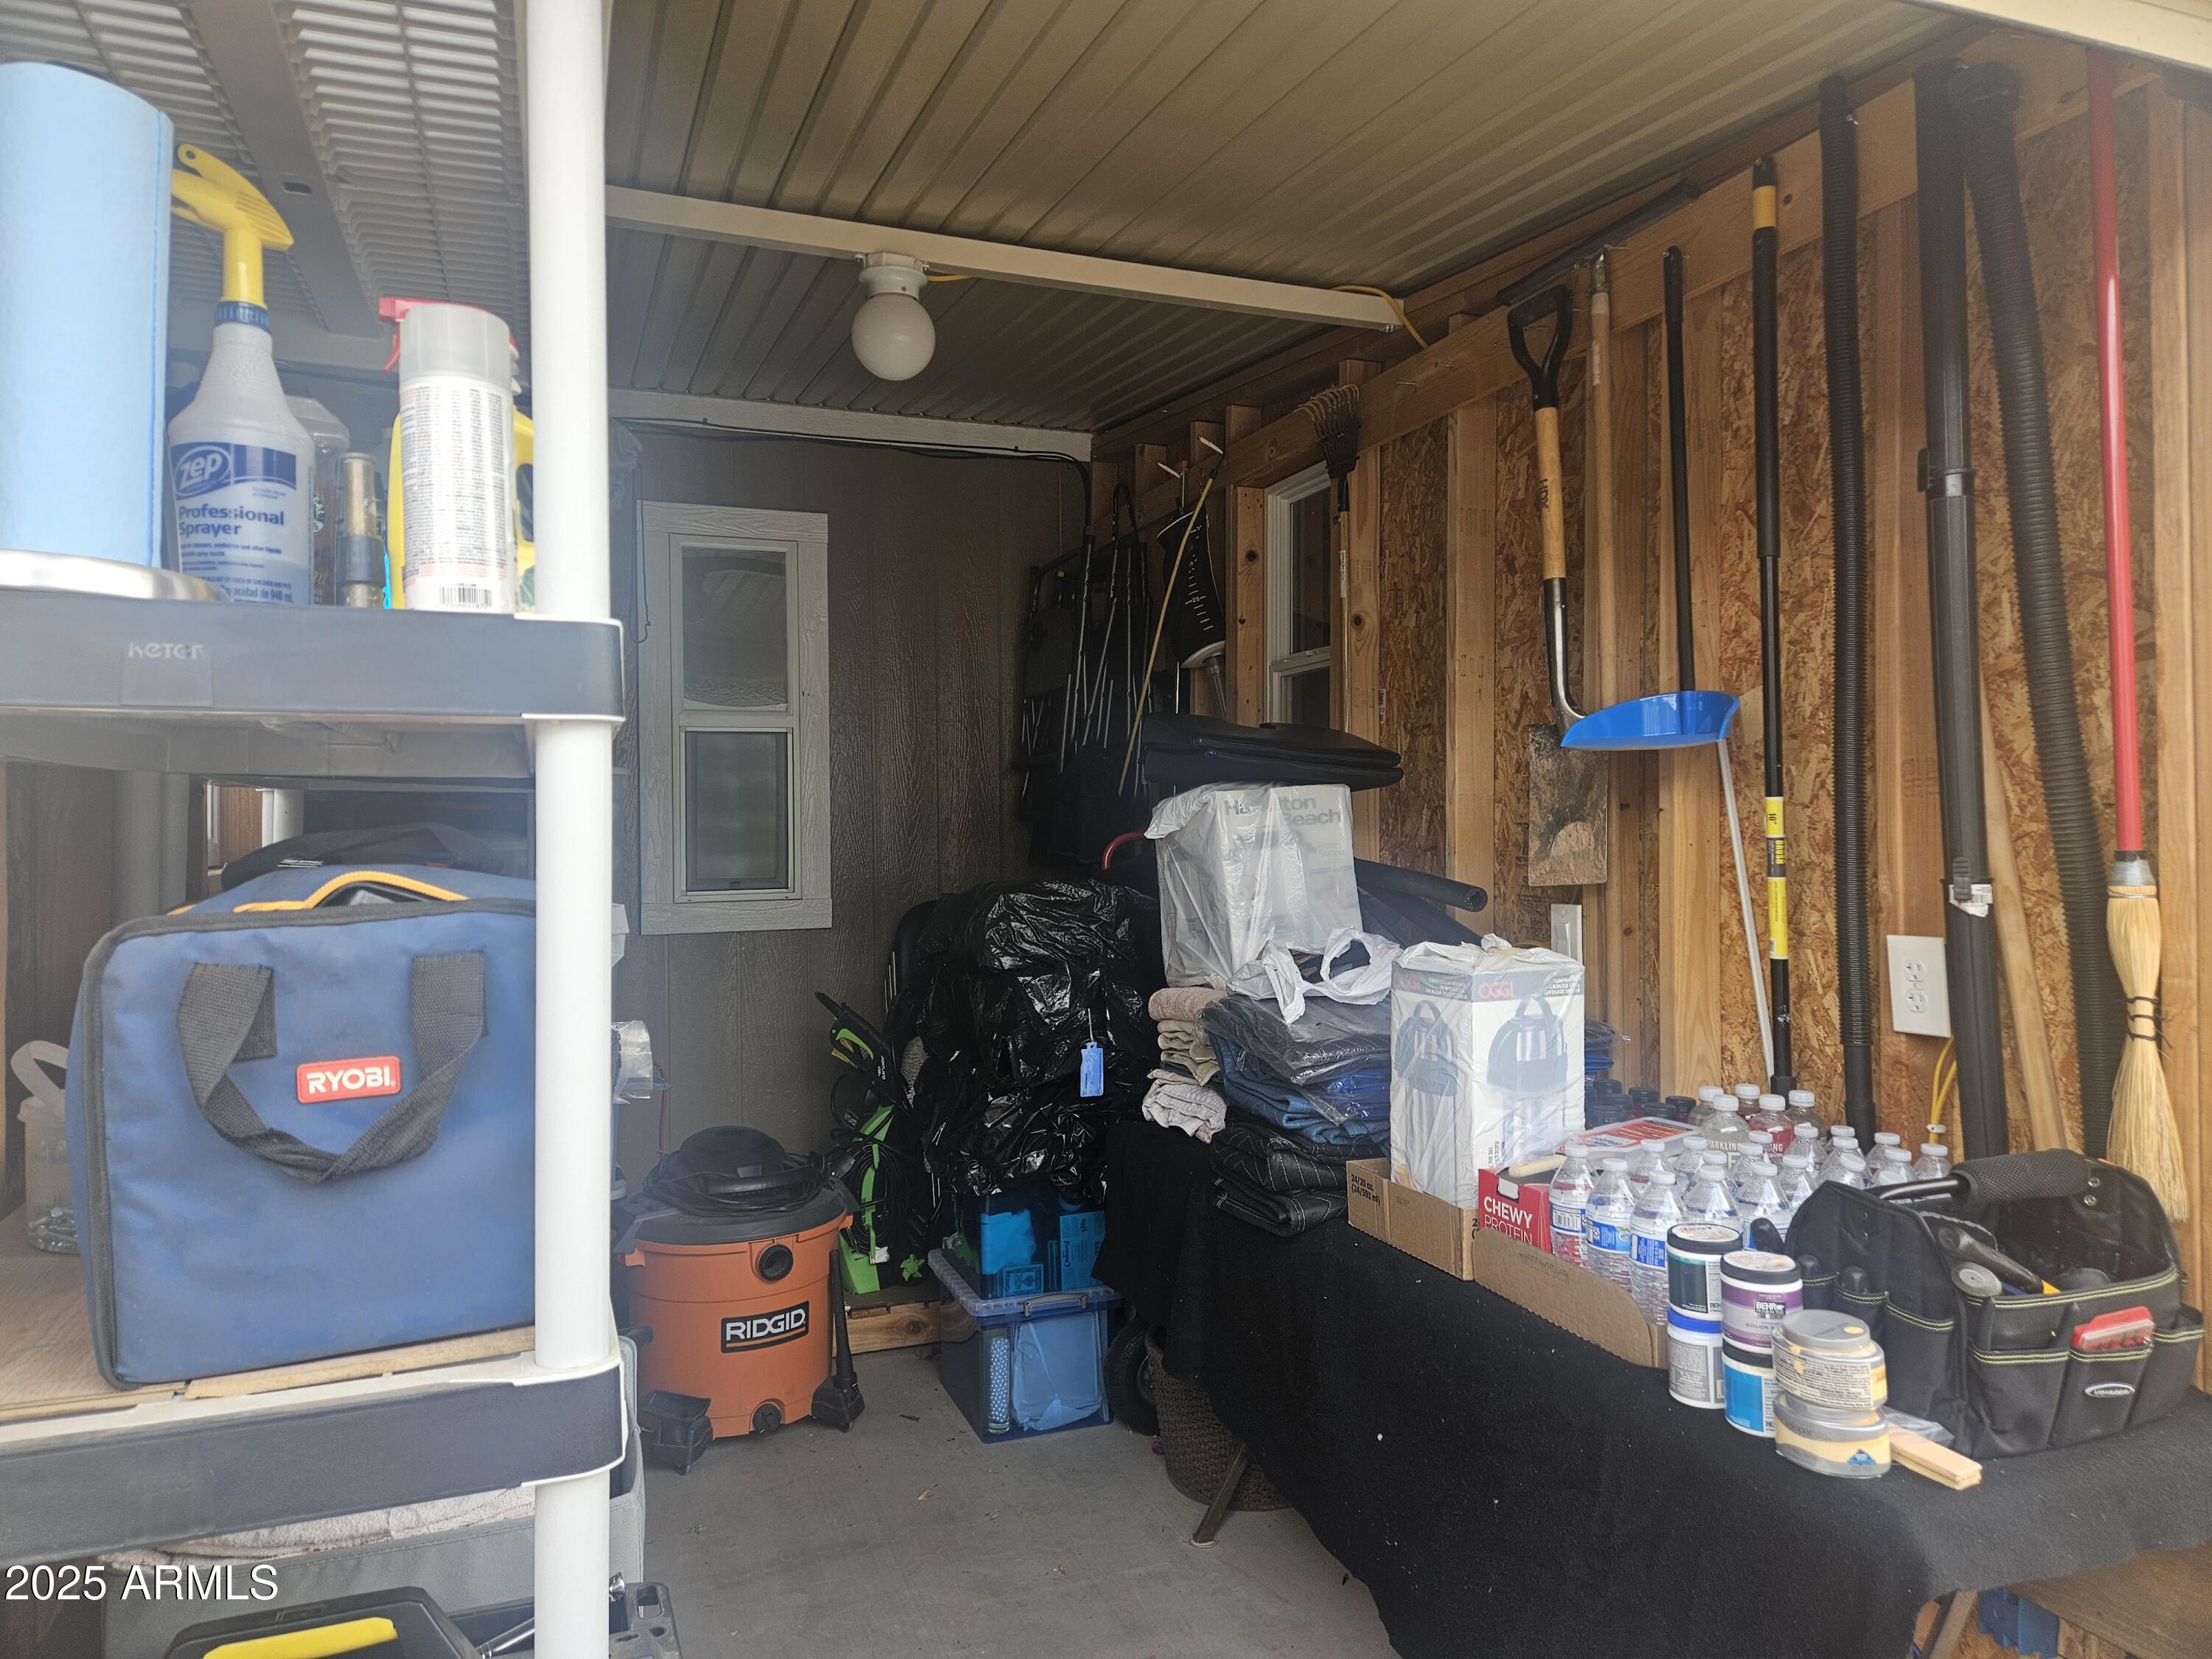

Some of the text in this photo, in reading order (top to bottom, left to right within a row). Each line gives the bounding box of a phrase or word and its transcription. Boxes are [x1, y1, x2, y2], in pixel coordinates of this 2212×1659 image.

[178, 504, 285, 526] Professional
[178, 522, 241, 538] Sprayer
[269, 588, 283, 602] 946
[1224, 796, 1316, 815] Haton
[1478, 980, 1514, 999] OGGI
[307, 1066, 390, 1094] RYOBI
[1707, 1138, 1741, 1152] PARKLIN
[1352, 1174, 1366, 1187] 24/20
[1352, 1183, 1371, 1200] (24/591
[1484, 1196, 1533, 1229] CHEWY
[1756, 1301, 1776, 1310] BEHR
[726, 1308, 806, 1341] RIDGID
